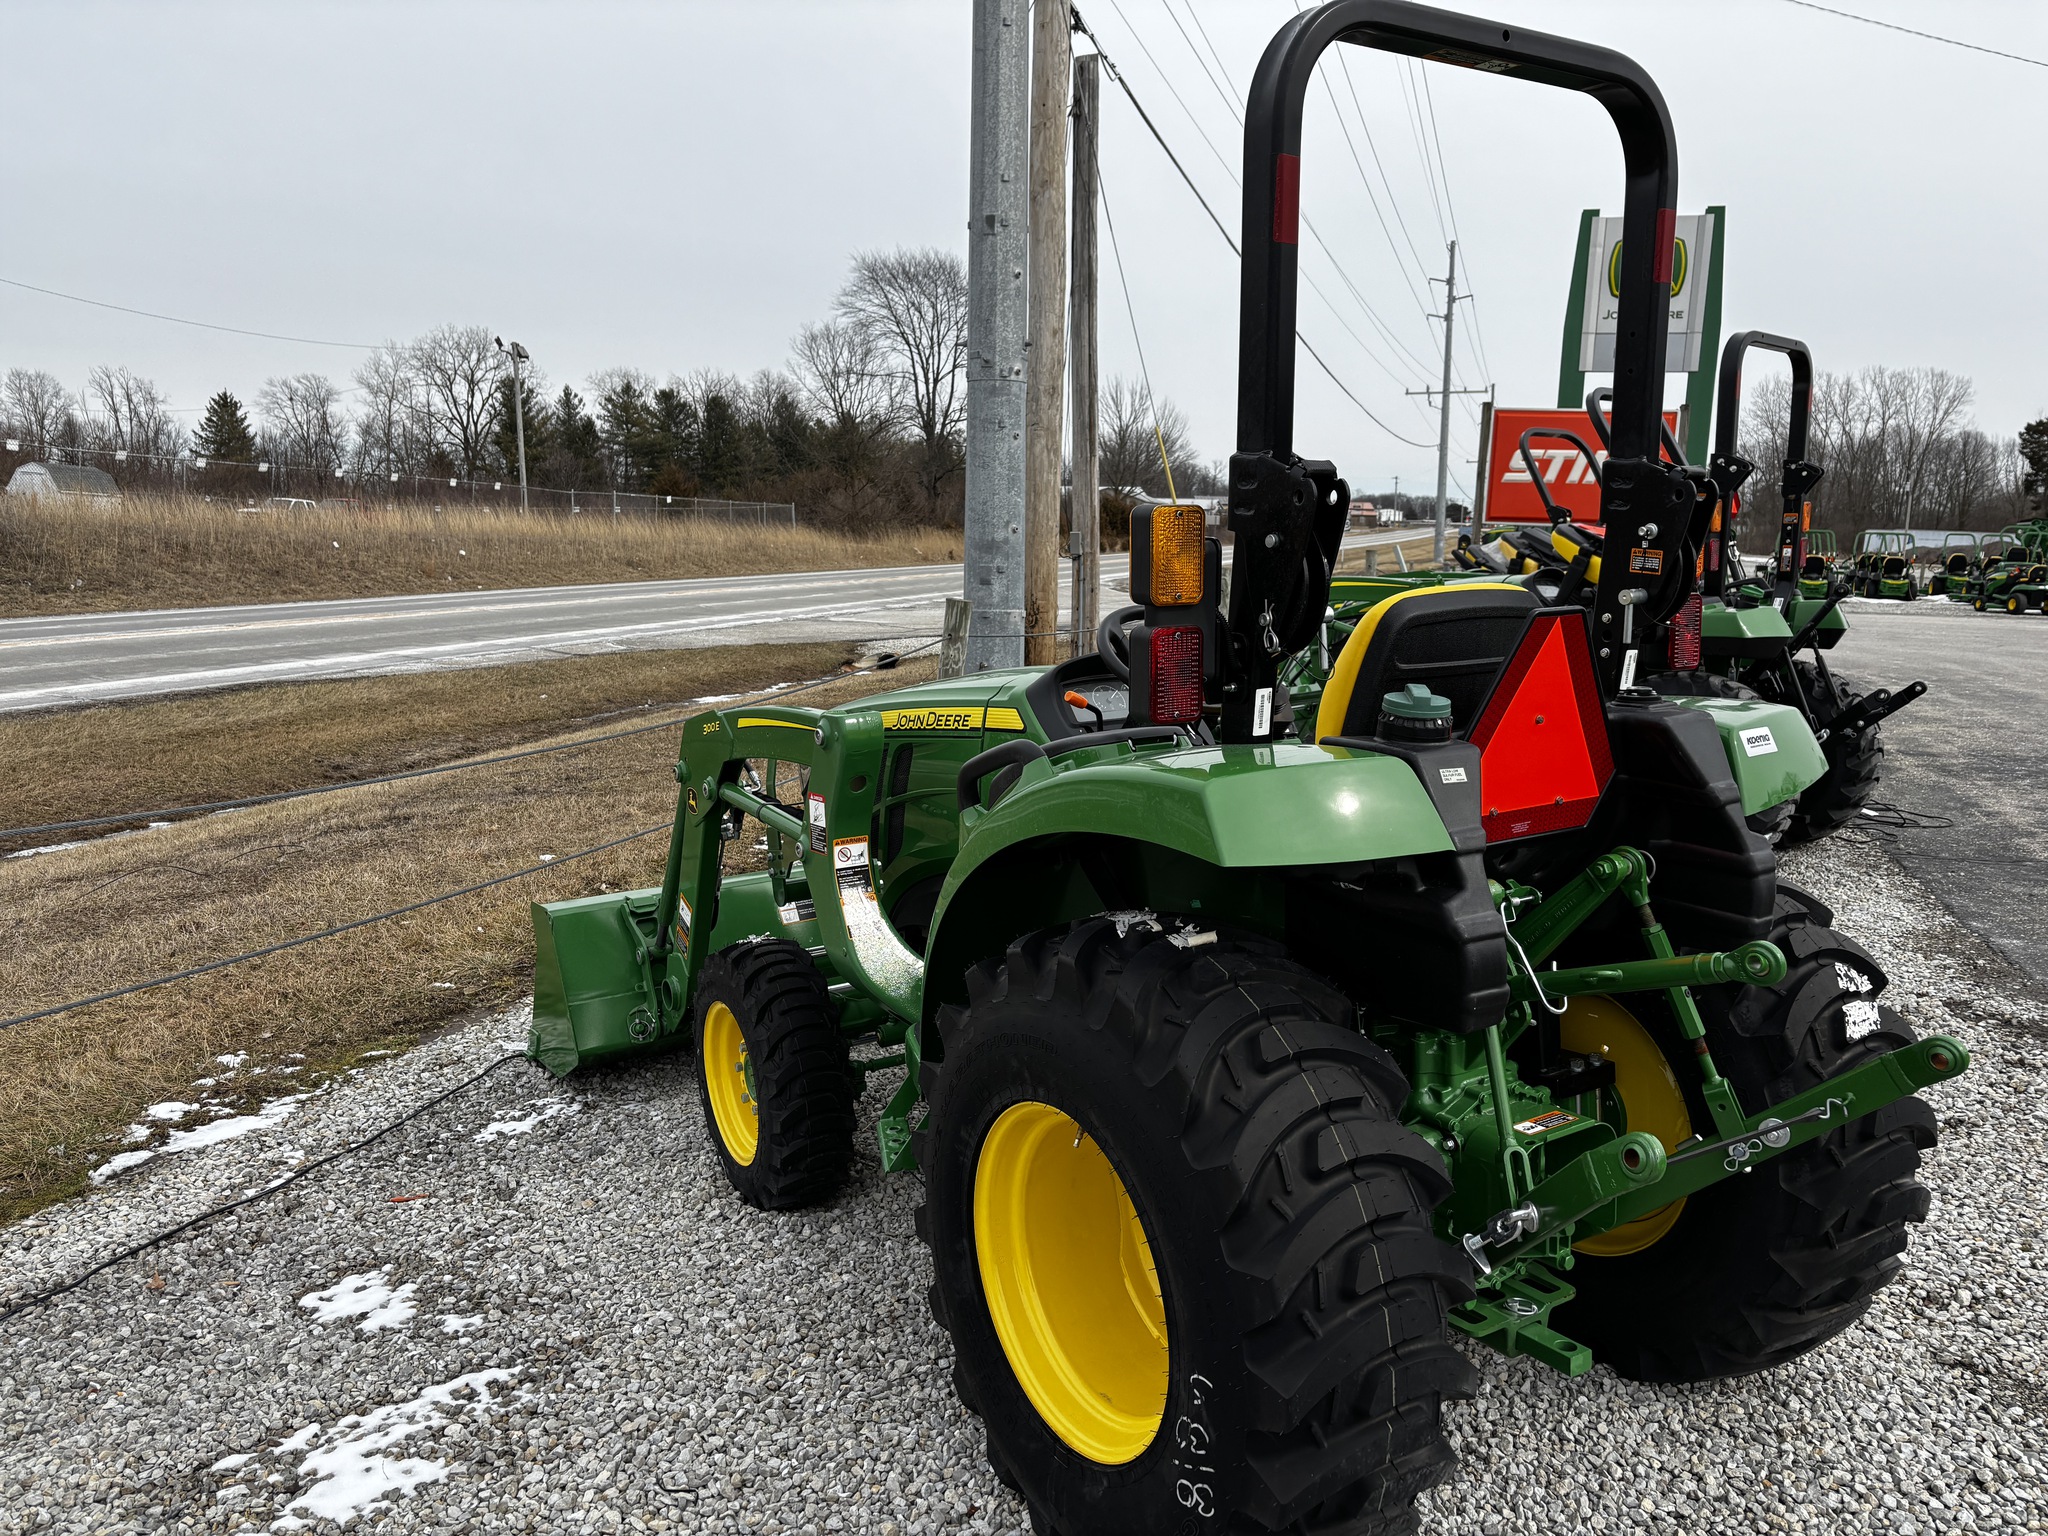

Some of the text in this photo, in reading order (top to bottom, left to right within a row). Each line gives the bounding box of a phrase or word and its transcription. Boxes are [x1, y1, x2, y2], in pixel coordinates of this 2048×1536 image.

[1501, 449, 1609, 485] STI
[703, 721, 720, 735] 300E
[892, 711, 972, 729] JOHN DEERE
[840, 836, 867, 845] WARNING
